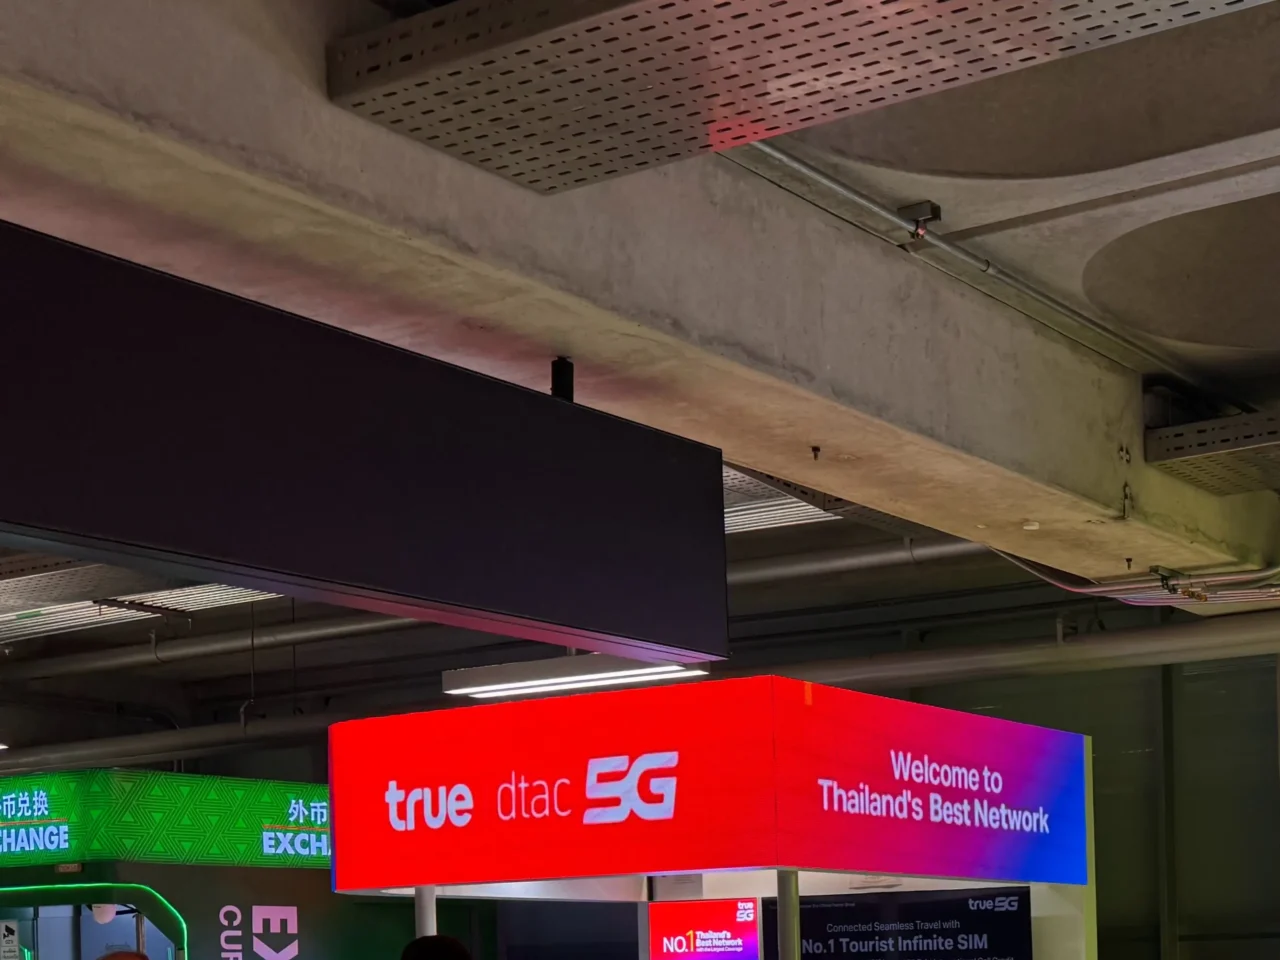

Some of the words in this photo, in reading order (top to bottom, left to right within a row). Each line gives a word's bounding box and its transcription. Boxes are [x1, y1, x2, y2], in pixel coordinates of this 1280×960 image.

[890, 749, 980, 791] Welcome
[982, 765, 1003, 794] to
[0, 790, 48, 818] 币兑换
[385, 780, 474, 831] true
[496, 770, 572, 821] dtac
[583, 751, 679, 825] 5G
[289, 799, 328, 825] 外币
[817, 778, 924, 821] Thailand's
[929, 792, 972, 827] Best
[974, 798, 1050, 834] Network
[0, 825, 69, 852] HANGE
[262, 831, 331, 856] EXCH
[968, 898, 993, 911] true
[994, 896, 1019, 911] 5G
[826, 921, 872, 933] Connected
[874, 920, 914, 932] Seamless
[916, 920, 941, 930] Travel
[942, 919, 961, 929] with
[662, 929, 695, 954] NO.1
[801, 938, 835, 954] No.1
[839, 936, 895, 953] Tourist
[898, 934, 954, 951] Infinite
[957, 933, 989, 949] SIM
